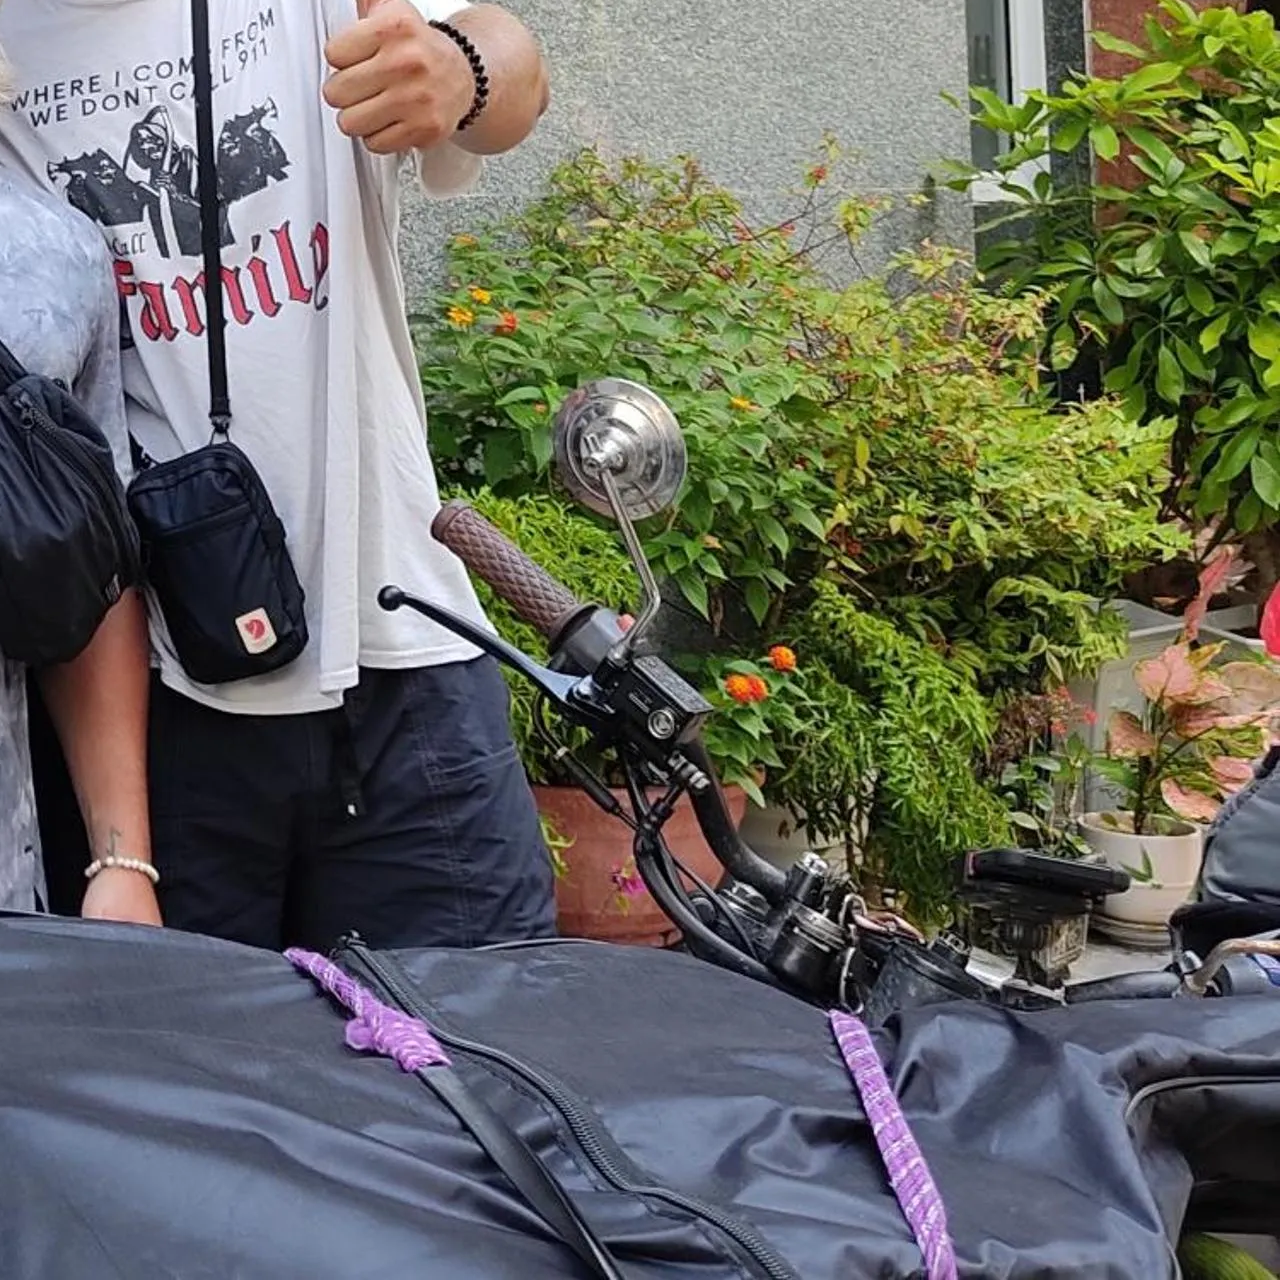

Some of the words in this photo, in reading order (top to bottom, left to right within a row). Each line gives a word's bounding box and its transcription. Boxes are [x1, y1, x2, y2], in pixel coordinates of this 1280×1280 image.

[11, 75, 102, 113] WHERE
[115, 71, 120, 88] I
[133, 55, 197, 83] COM
[221, 8, 275, 59] FROM
[30, 103, 69, 128] WE
[81, 85, 158, 117] DONT
[238, 37, 269, 71] 911
